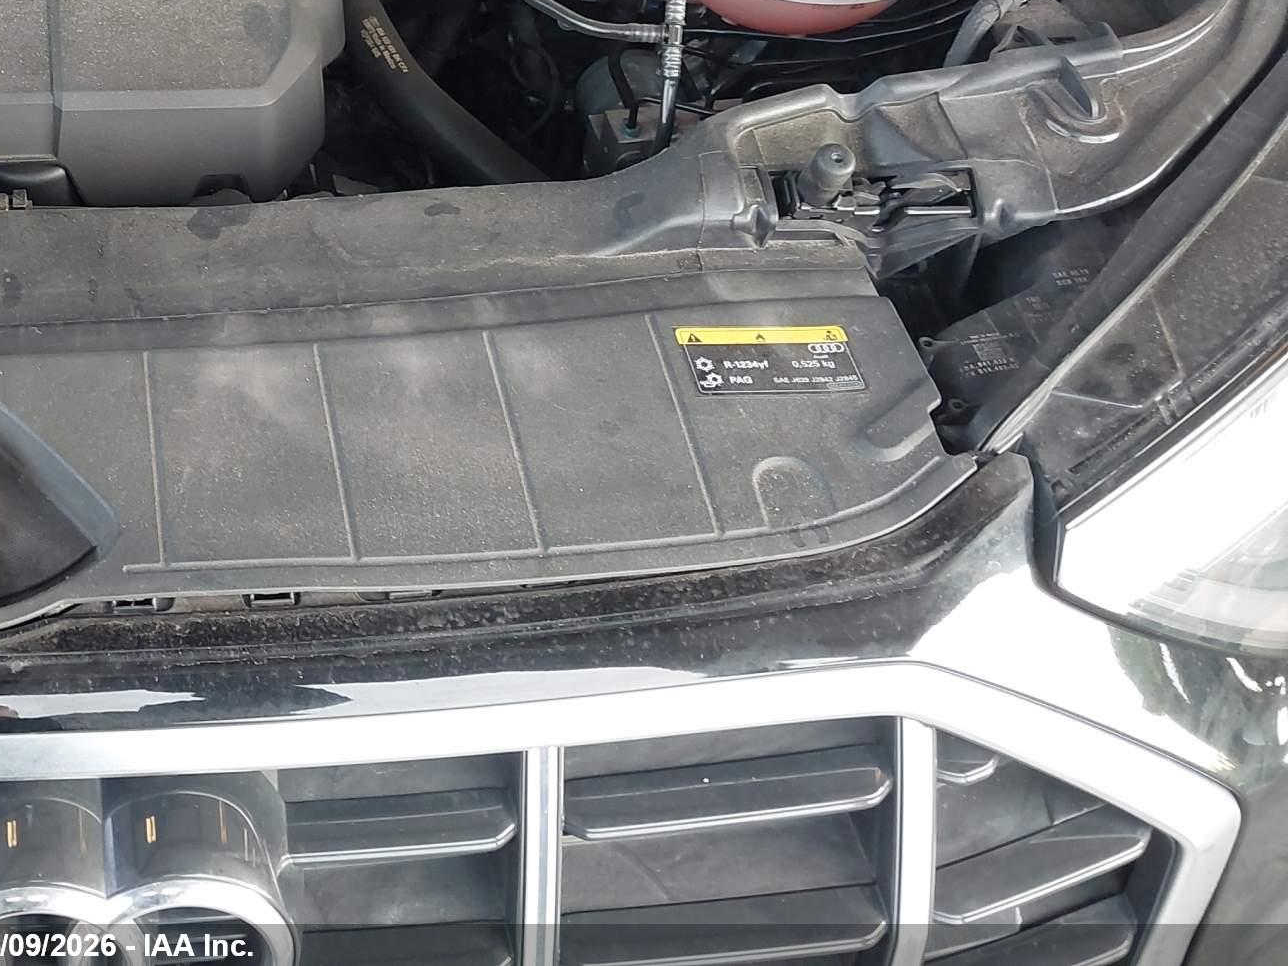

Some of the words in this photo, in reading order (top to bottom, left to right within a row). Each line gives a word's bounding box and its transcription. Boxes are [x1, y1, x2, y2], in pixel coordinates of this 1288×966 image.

[723, 360, 769, 370] R-1234yf
[791, 360, 820, 369] 0,525
[822, 360, 836, 369] kg
[729, 376, 753, 384] PAG
